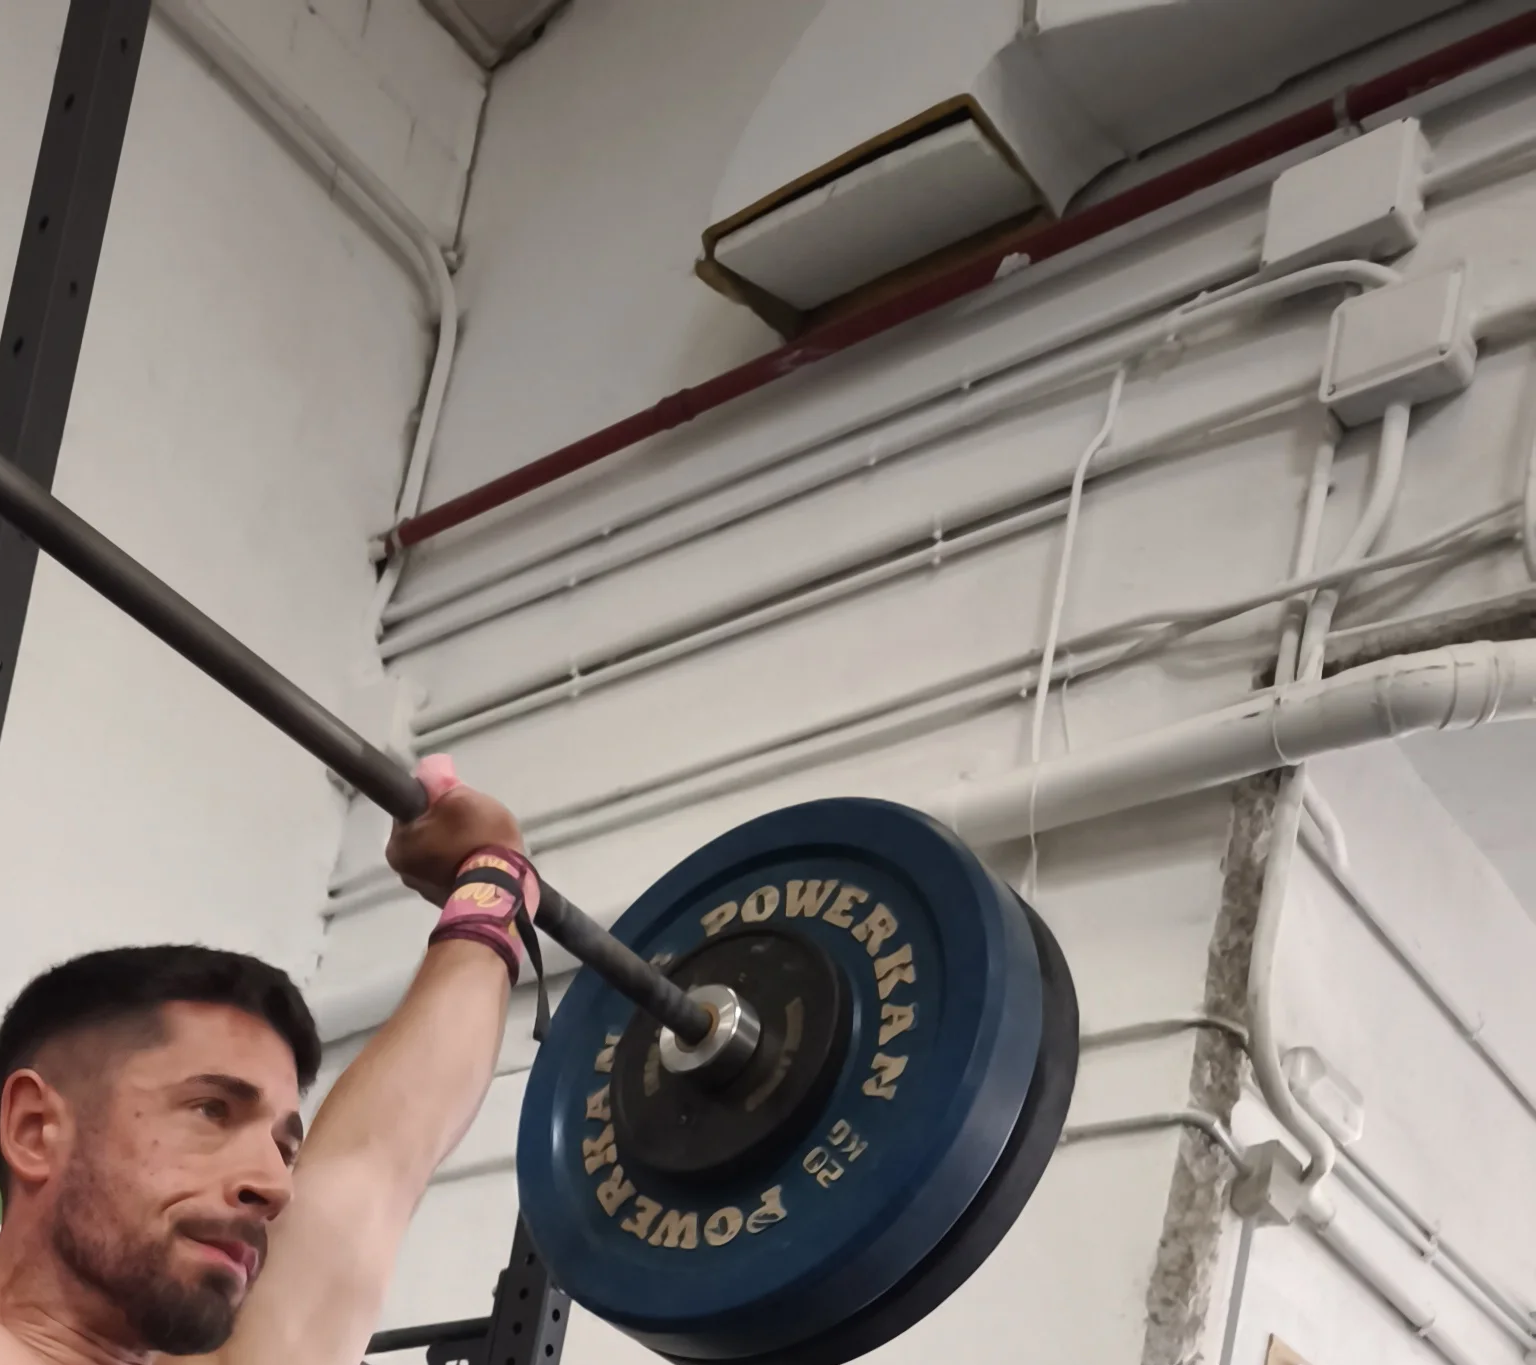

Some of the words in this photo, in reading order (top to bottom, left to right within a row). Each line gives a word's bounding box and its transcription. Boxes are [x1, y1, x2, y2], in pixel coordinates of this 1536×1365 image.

[700, 879, 919, 1101] POWERKAN
[582, 1032, 789, 1250] POWERKAN
[802, 1146, 845, 1189] 20
[826, 1118, 869, 1162] KG
